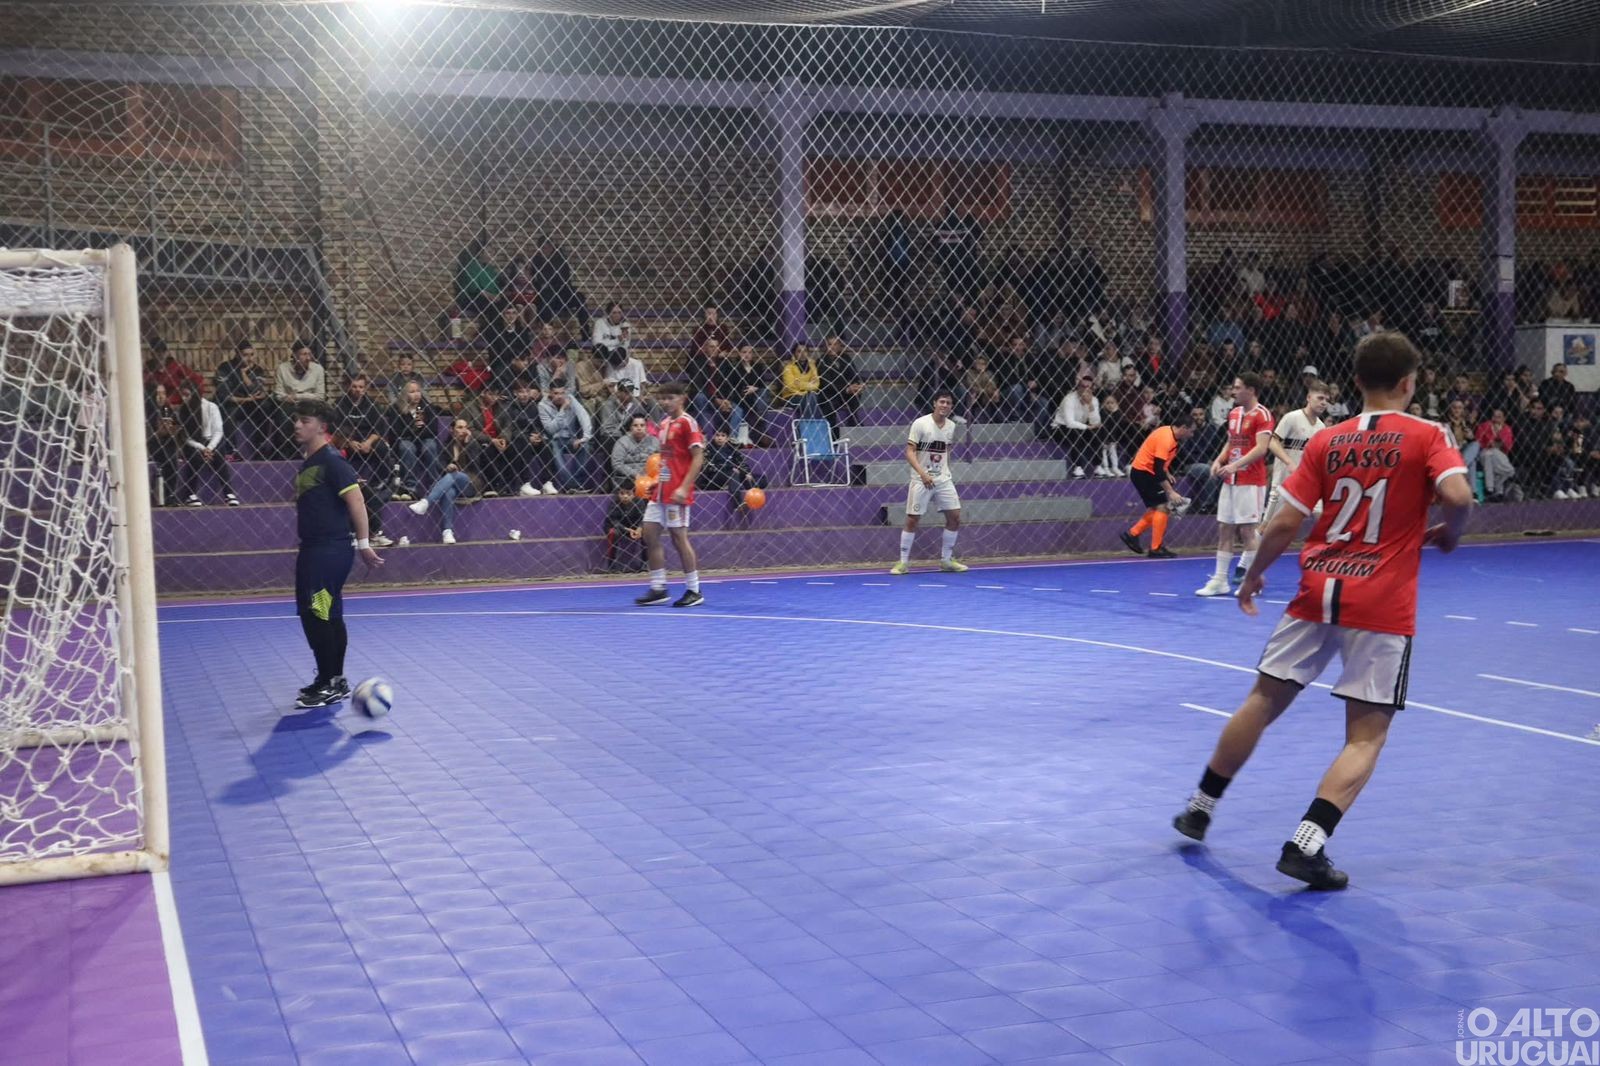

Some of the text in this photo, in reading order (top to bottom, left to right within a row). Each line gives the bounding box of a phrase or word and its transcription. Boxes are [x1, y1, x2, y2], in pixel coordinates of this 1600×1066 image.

[1329, 432, 1403, 447] ERVA MATE
[1327, 448, 1401, 474] BASSO
[1327, 475, 1388, 545] 21
[1303, 556, 1376, 577] DRUMM
